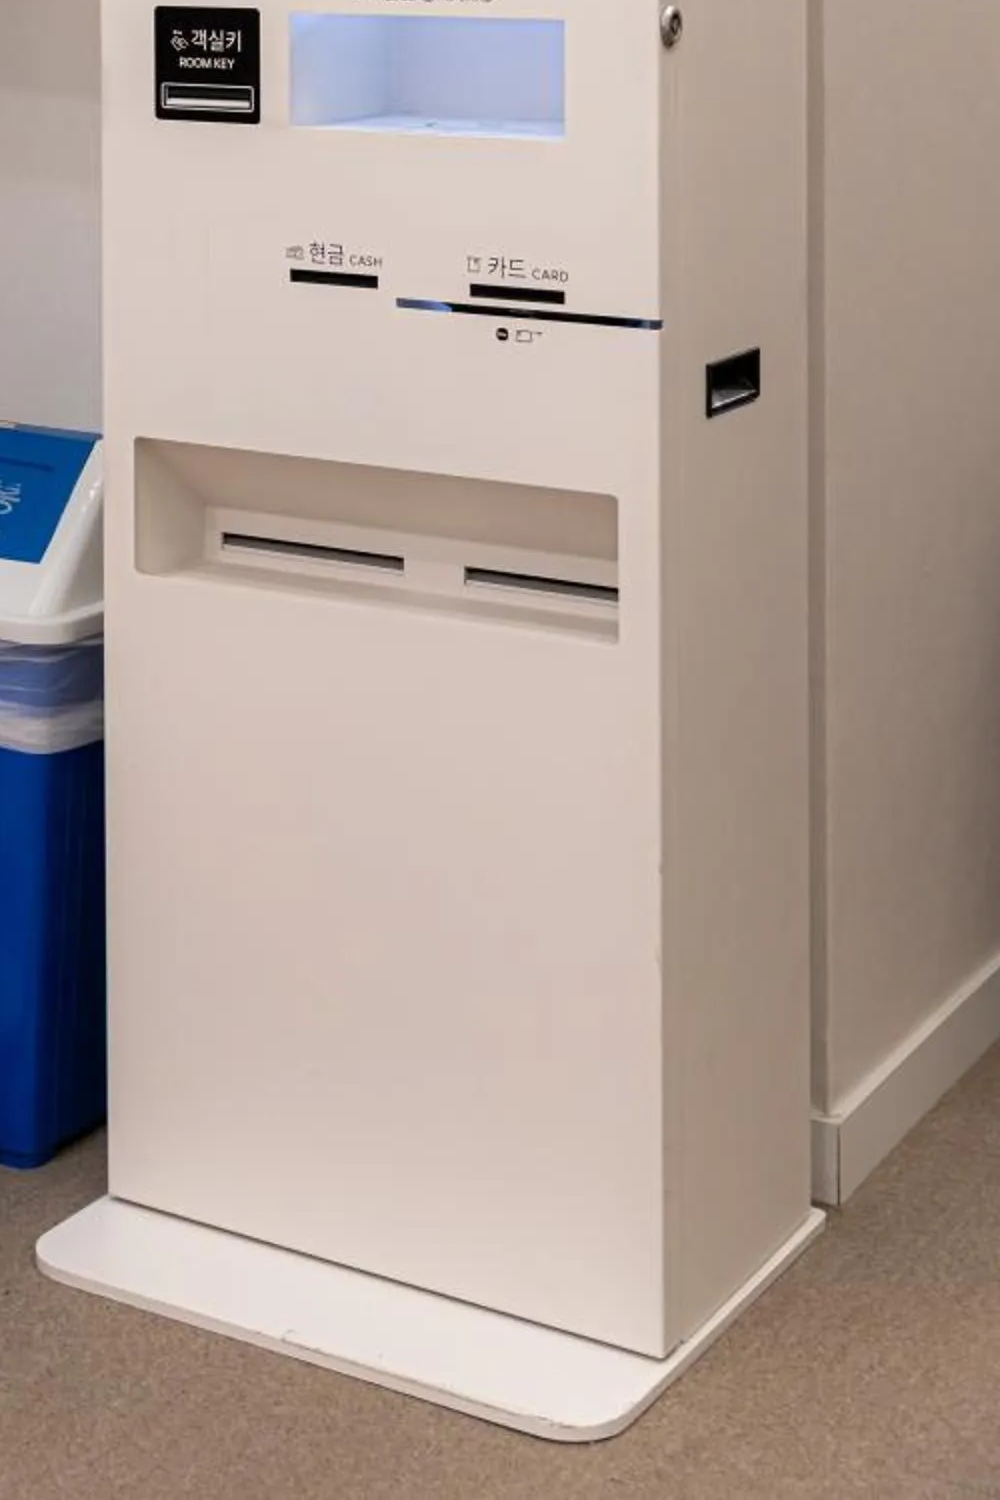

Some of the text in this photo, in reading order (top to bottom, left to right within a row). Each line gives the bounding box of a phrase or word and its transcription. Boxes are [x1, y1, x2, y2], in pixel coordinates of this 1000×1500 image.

[190, 29, 241, 53] 객실키
[179, 56, 236, 70] ROOM KEY
[309, 241, 382, 268] 현금 CASH
[488, 256, 569, 283] 카드 CARD
